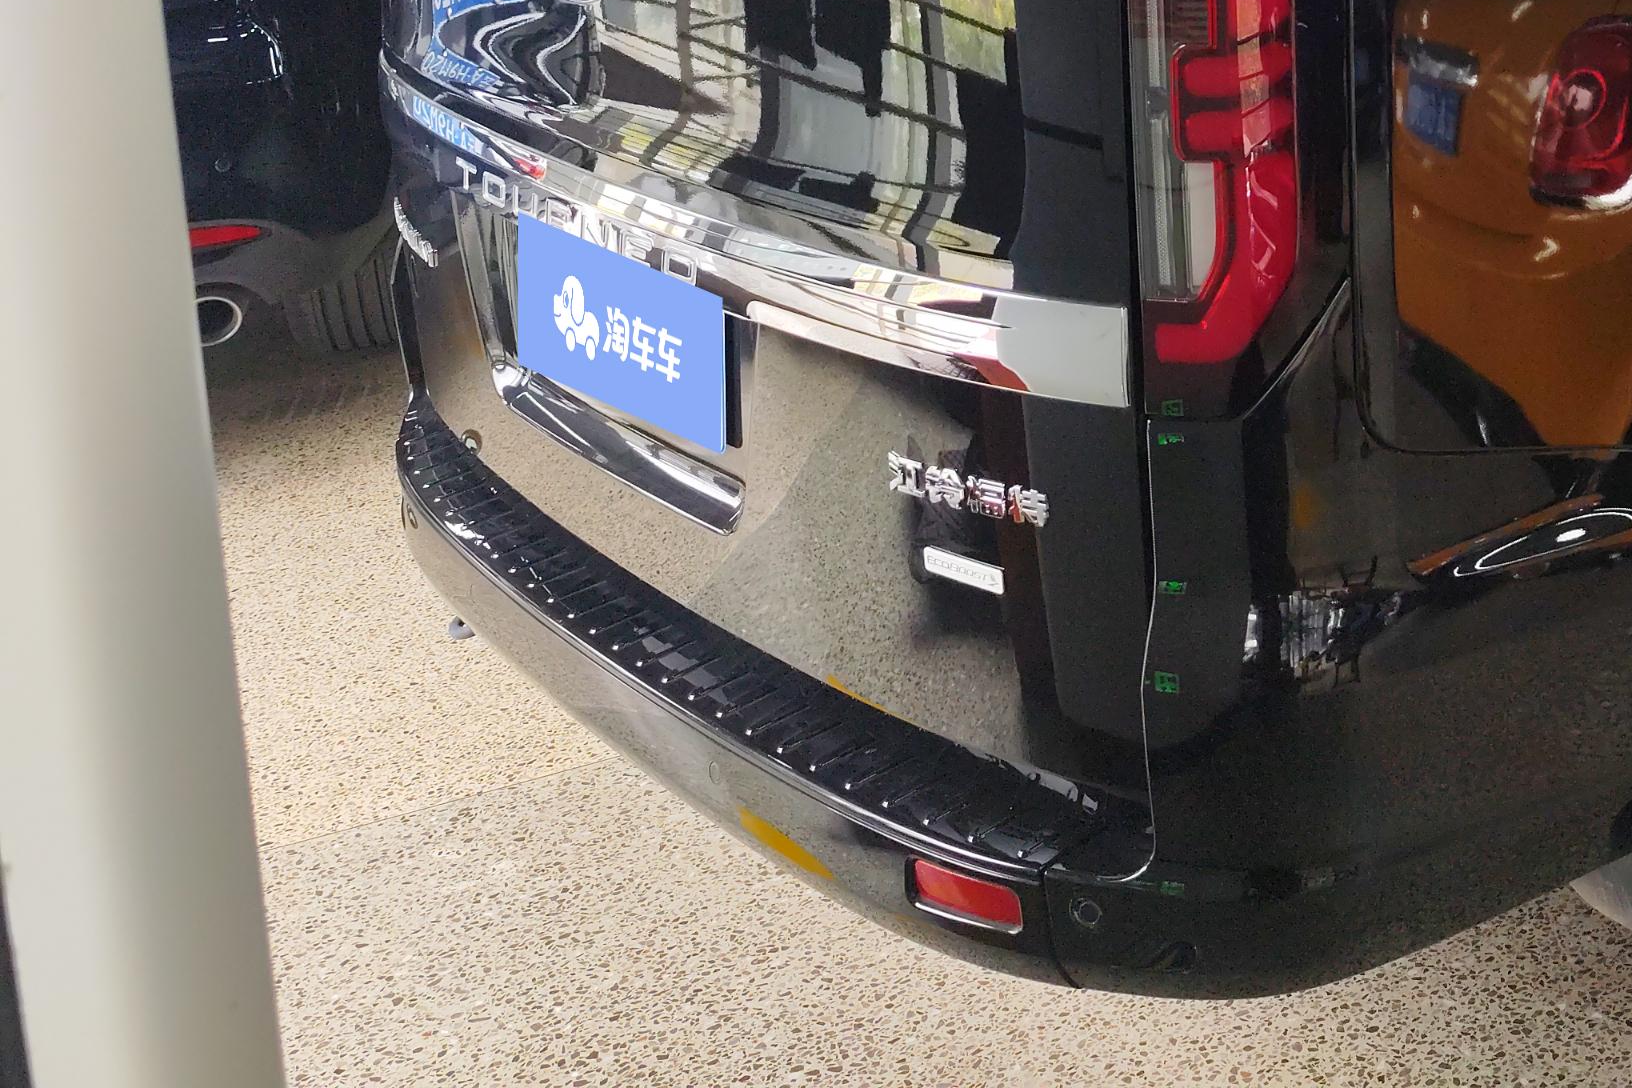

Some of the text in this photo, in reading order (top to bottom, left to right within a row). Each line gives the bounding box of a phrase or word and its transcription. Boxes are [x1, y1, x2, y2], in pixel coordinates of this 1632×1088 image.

[456, 157, 698, 286] TOURNEO
[887, 450, 1050, 528] 江铃福特
